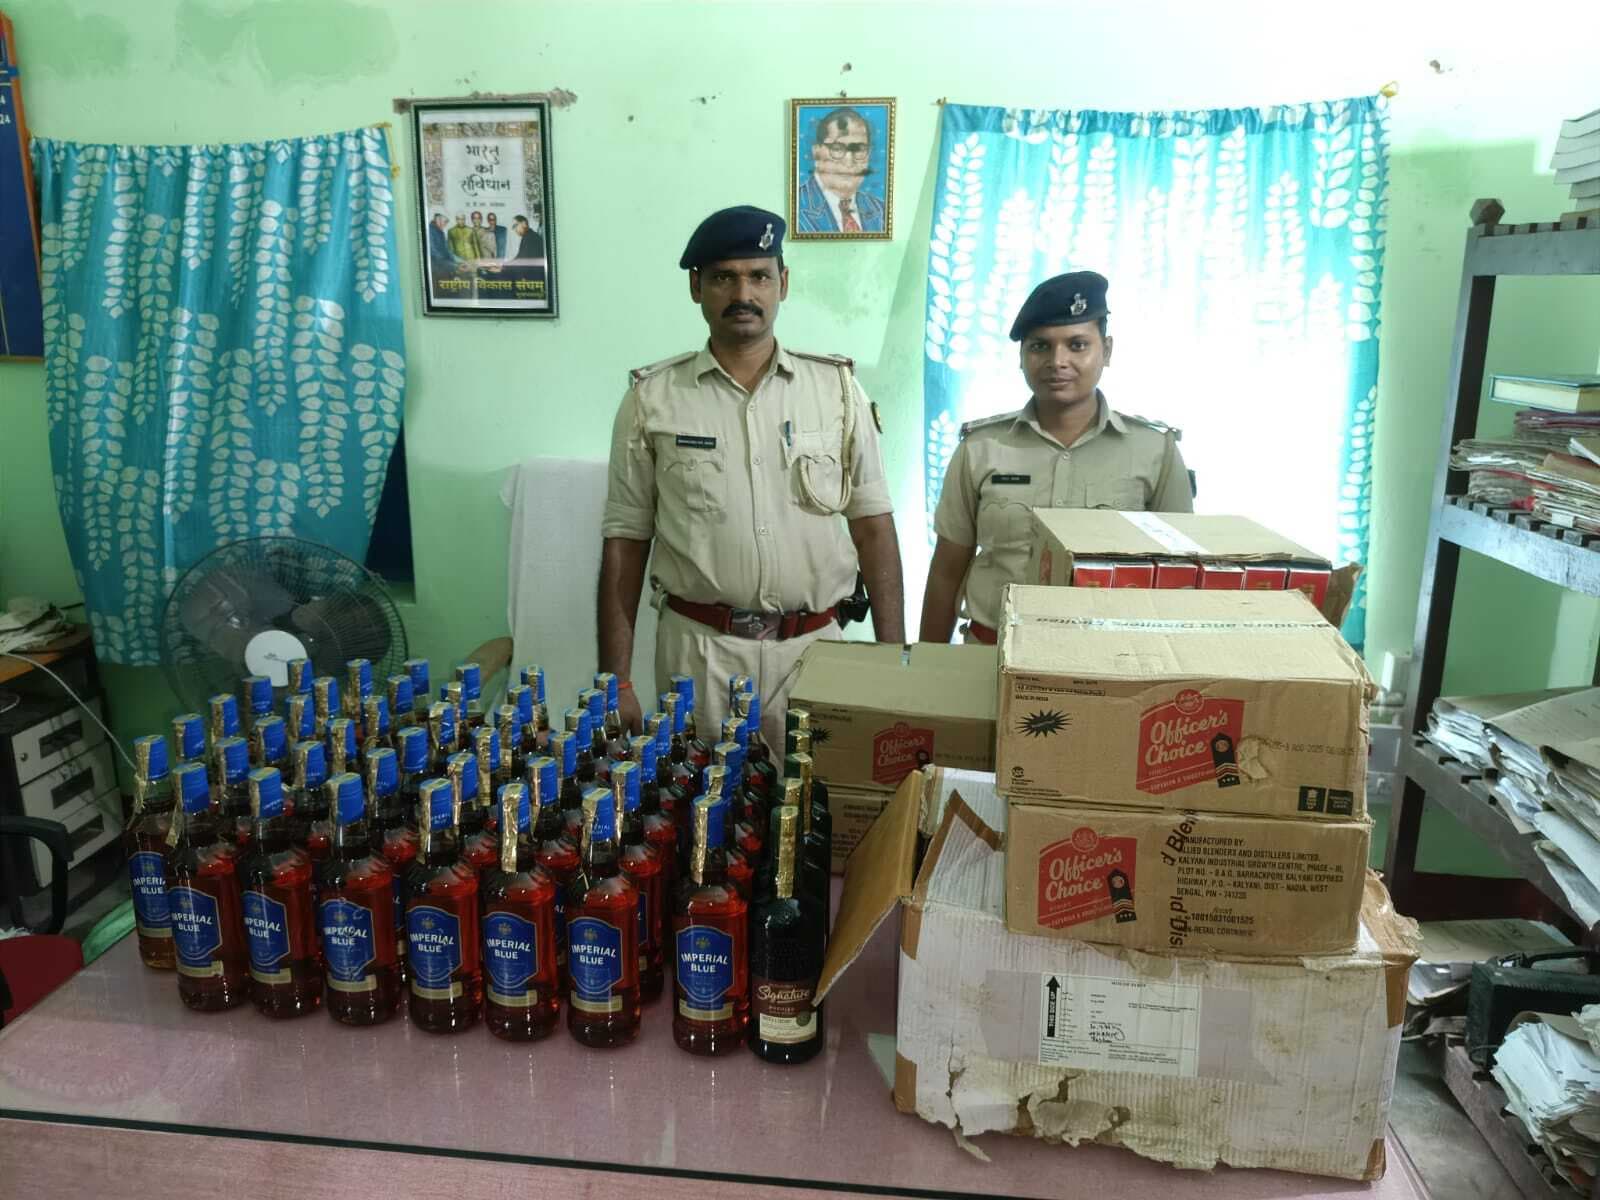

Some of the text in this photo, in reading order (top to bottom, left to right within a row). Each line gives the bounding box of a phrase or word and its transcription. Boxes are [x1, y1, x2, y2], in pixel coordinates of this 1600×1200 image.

[474, 164, 494, 174] का
[1150, 709, 1228, 745] Officer's
[1145, 740, 1207, 766] Choice
[1181, 847, 1202, 855] LLIED
[1203, 847, 1237, 857] BLENDERS
[1238, 849, 1251, 858] AND
[1049, 848, 1122, 881] Officer's
[1178, 857, 1206, 866] KALYANI
[1207, 858, 1245, 868] INDUSTRIAL
[1248, 860, 1276, 870] GROWTH
[1177, 867, 1194, 875] PLOT
[133, 877, 166, 886] IMPERI
[141, 886, 164, 895] BLUE
[1045, 876, 1103, 901] Choice
[1205, 889, 1217, 898] PIN
[178, 924, 201, 932] BLUE
[249, 927, 270, 938] BLUE
[331, 936, 355, 946] BLUE
[410, 933, 454, 945] IMPERIAL
[418, 943, 443, 953] BLUE
[486, 938, 531, 952] IMPERIAL
[494, 949, 519, 960] BLUE
[571, 944, 616, 958] IMPERIAL
[579, 956, 604, 965] BLUE
[681, 952, 728, 965] IMPERIAL
[690, 964, 716, 973] BLUE
[757, 984, 810, 1003] Signature
